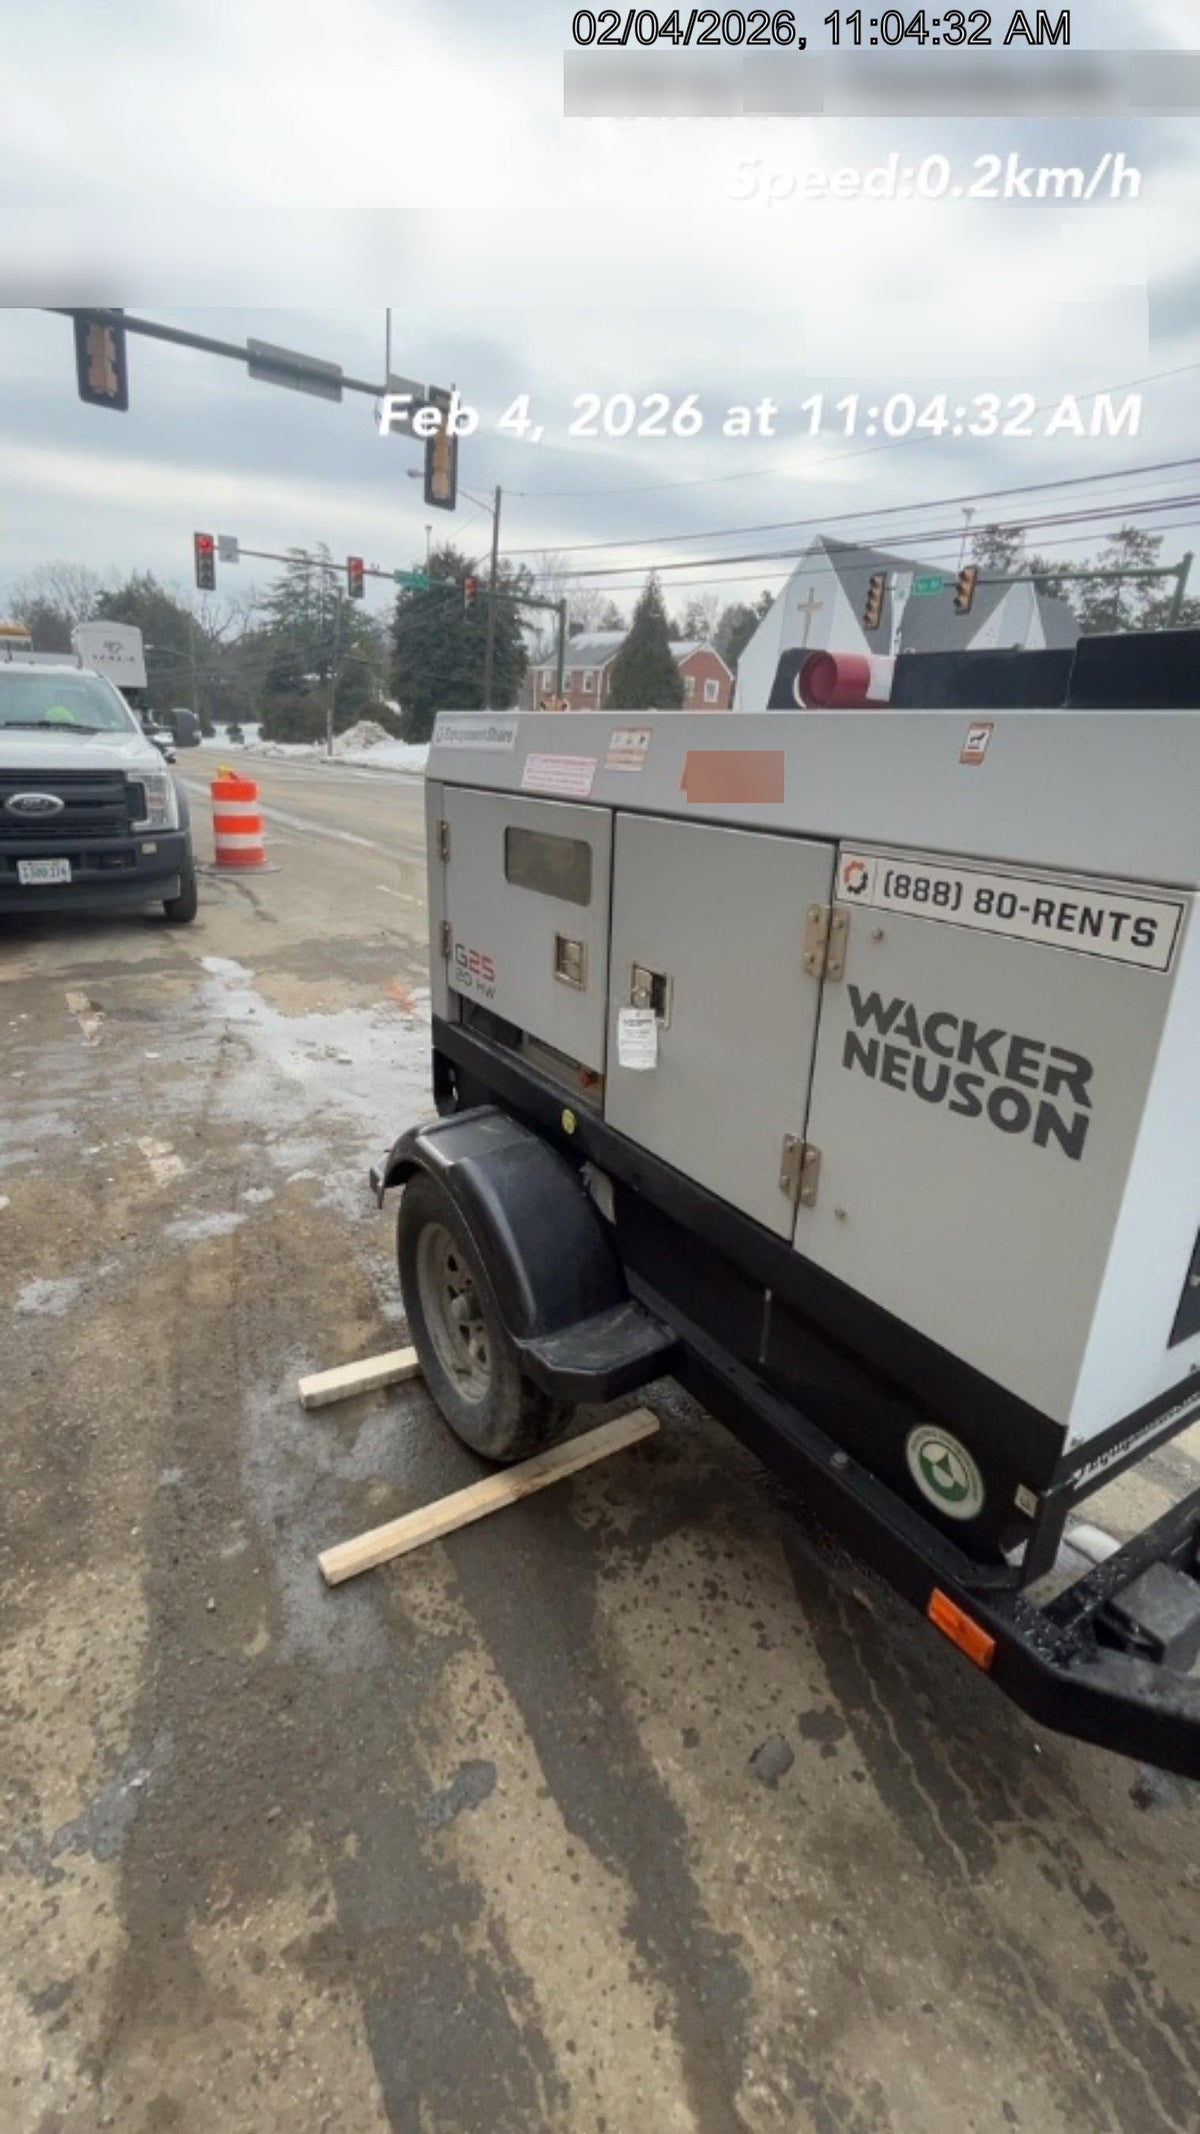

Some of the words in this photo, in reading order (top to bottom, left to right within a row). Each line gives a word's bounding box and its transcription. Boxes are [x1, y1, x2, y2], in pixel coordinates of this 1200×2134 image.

[884, 870, 963, 911] (888)
[974, 888, 1158, 948] 80-RENTS
[455, 943, 496, 982] G25
[842, 1031, 1090, 1161] NEUSON
[846, 983, 1094, 1109] WACKER
